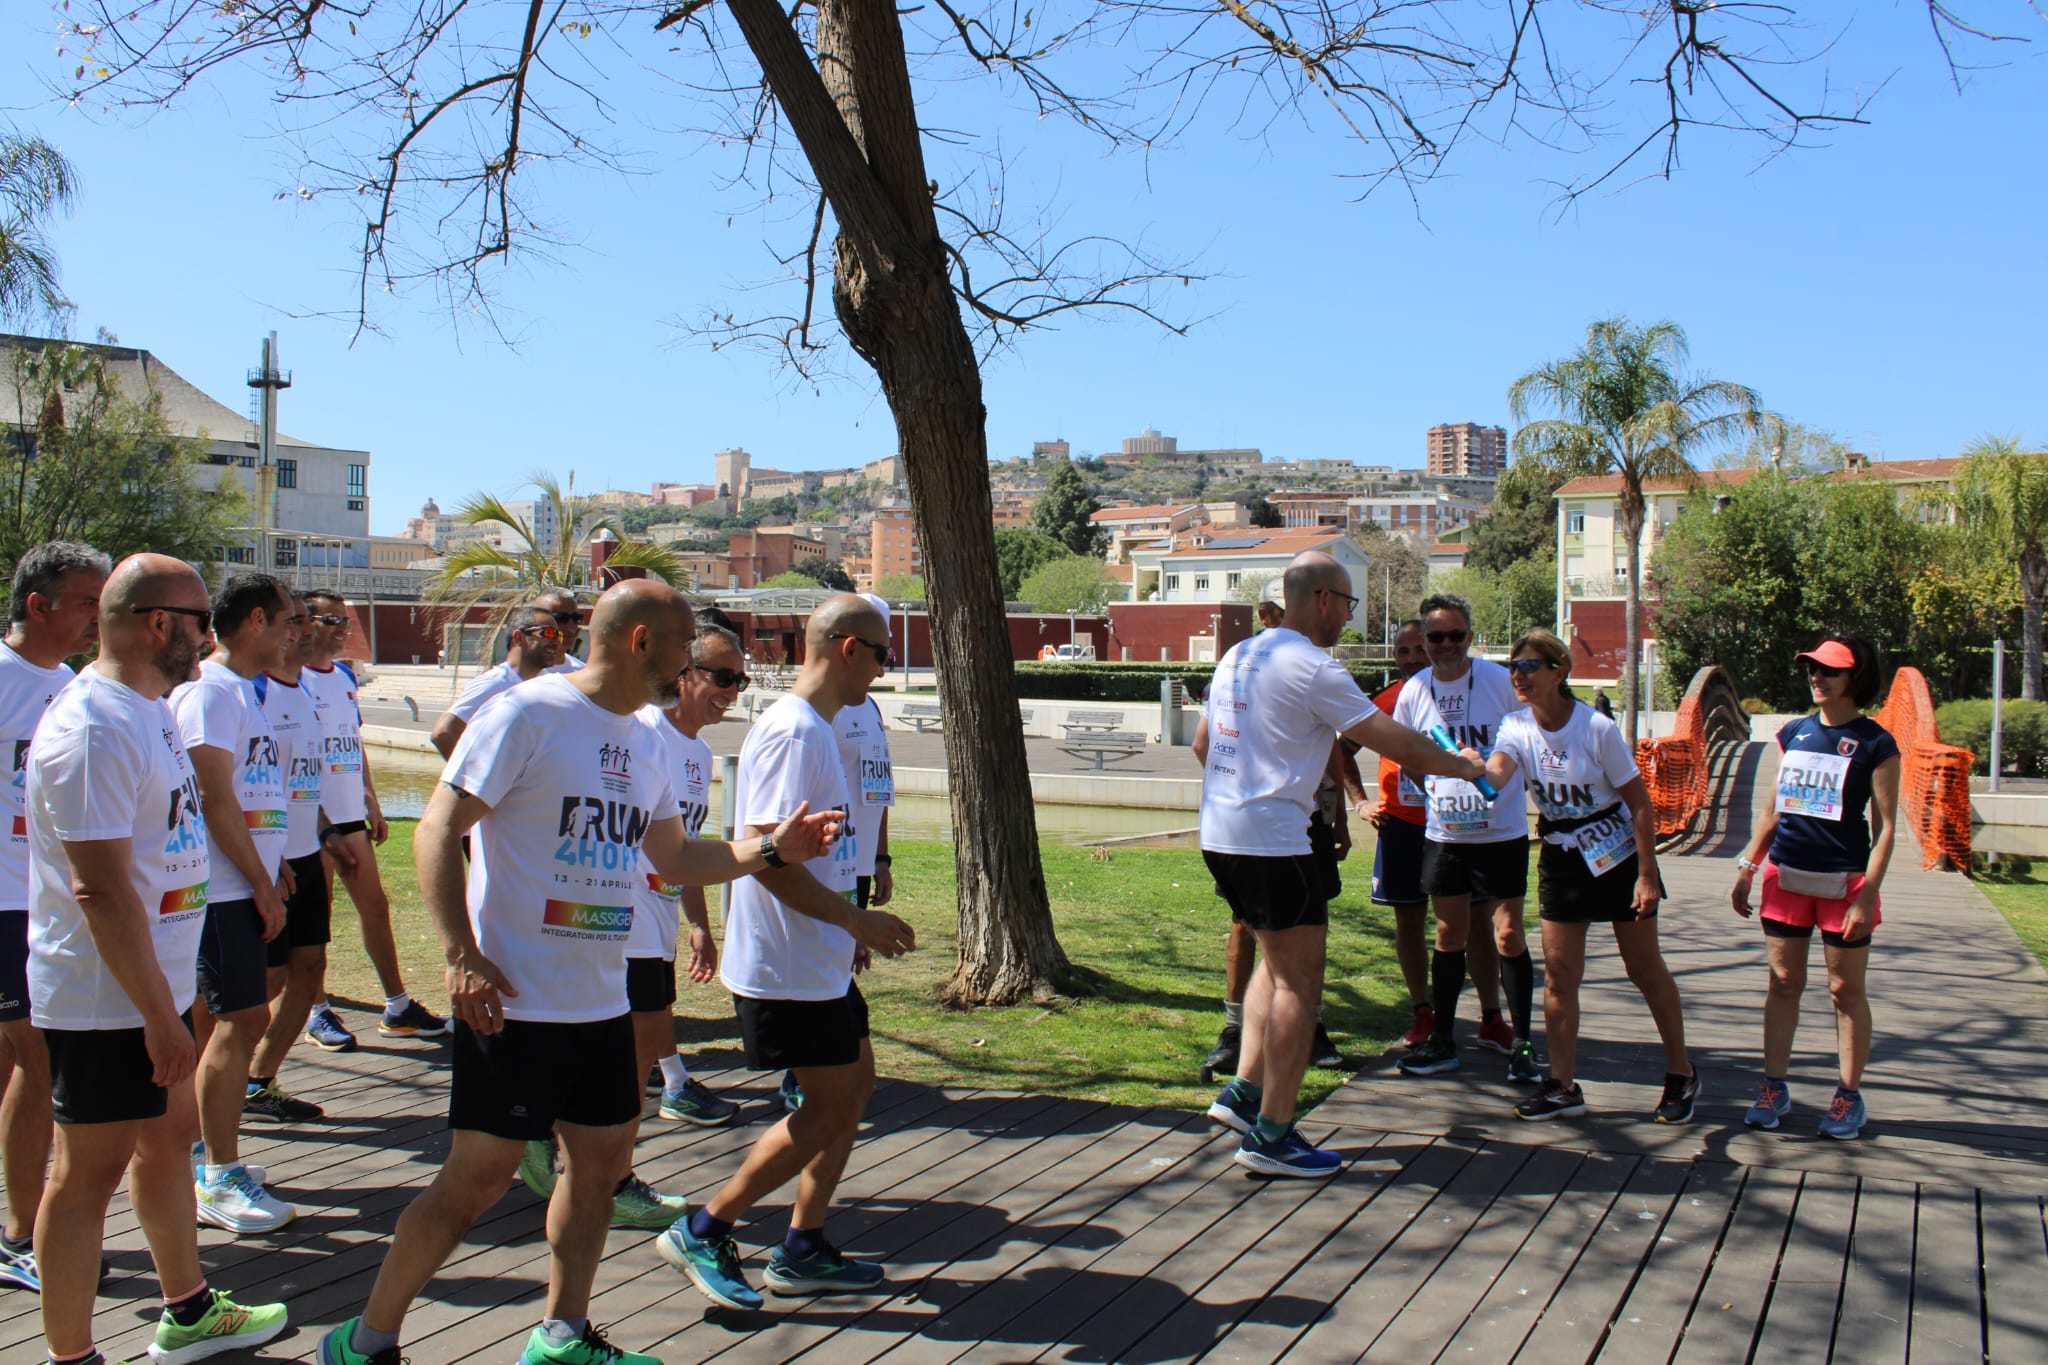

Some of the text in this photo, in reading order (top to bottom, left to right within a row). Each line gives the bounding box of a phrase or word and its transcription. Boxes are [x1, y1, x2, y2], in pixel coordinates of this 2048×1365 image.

[288, 776, 321, 789] 4HOP
[558, 796, 651, 847] RUN
[554, 873, 568, 883] 13
[585, 878, 598, 887] 21
